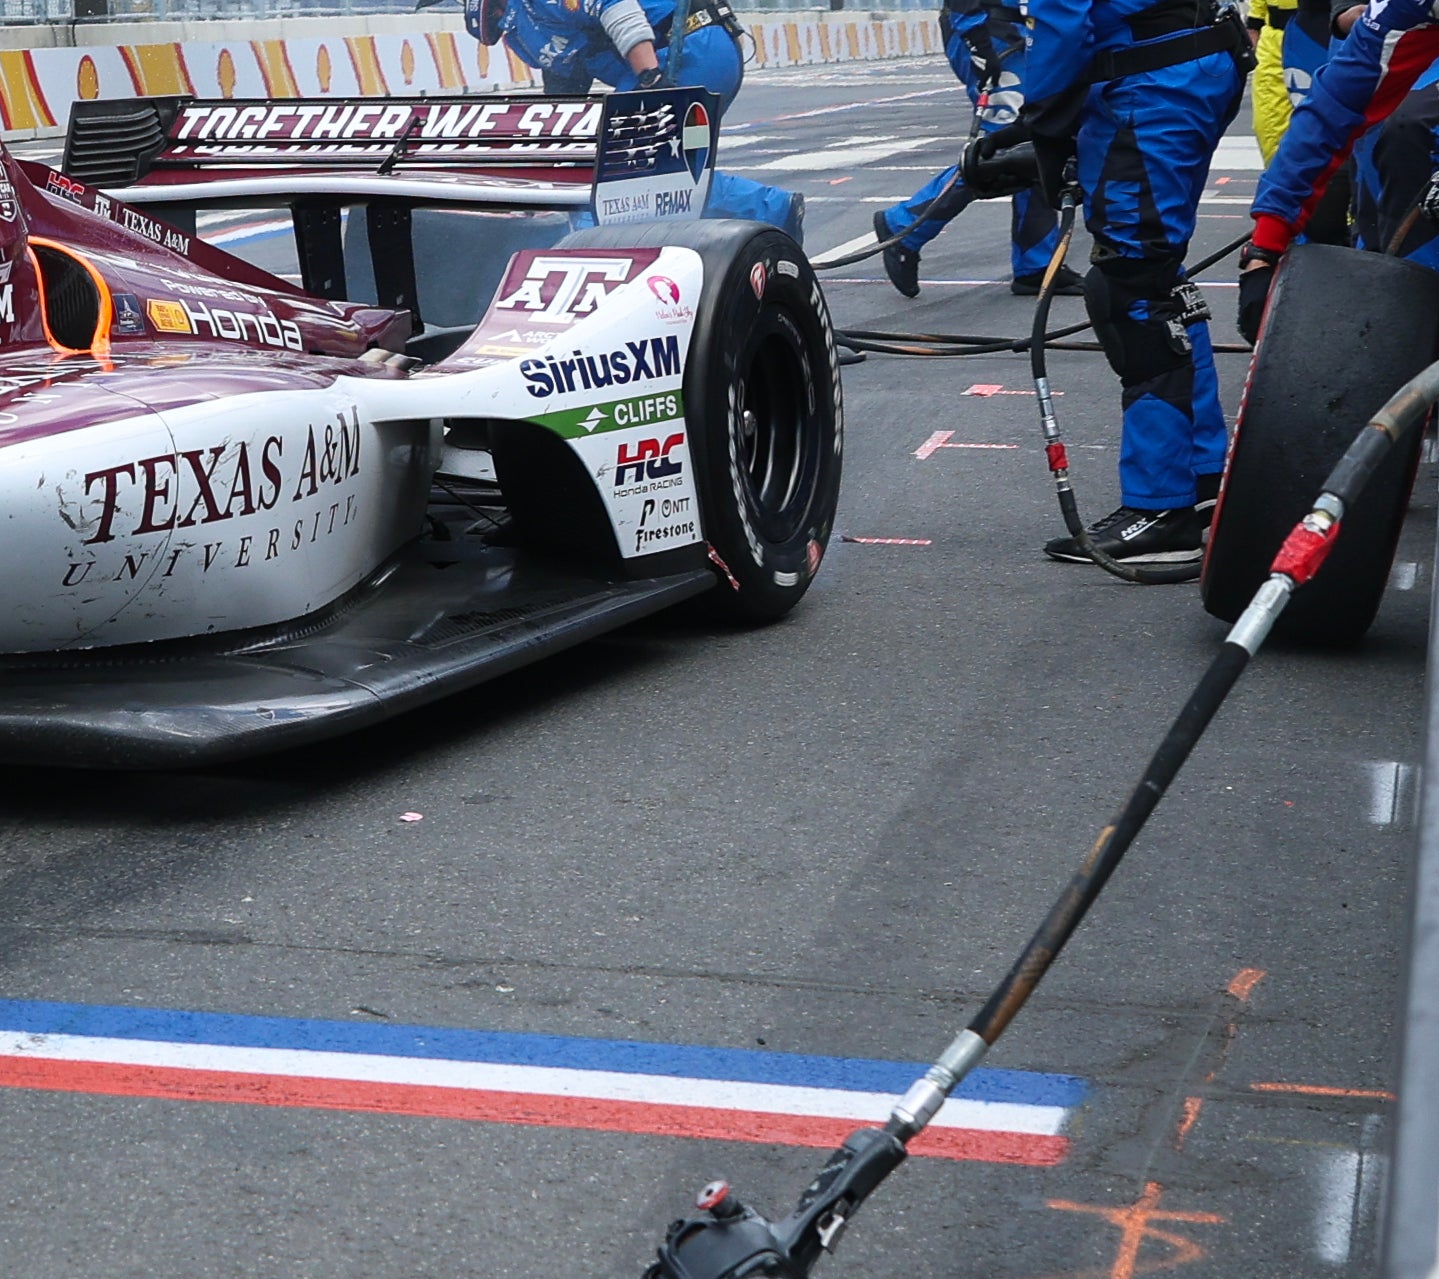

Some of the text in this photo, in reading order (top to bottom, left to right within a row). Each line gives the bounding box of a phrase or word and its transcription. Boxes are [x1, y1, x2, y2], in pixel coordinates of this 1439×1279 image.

[172, 105, 412, 153] TOGETHER
[419, 104, 512, 152] WE
[603, 197, 630, 216] TEXAS
[655, 189, 694, 217] REMAX
[122, 208, 162, 241] TEXAS
[163, 231, 189, 256] A&M
[161, 279, 237, 302] Powered
[179, 299, 303, 352] Honda
[519, 335, 681, 398] SiriusXM
[614, 395, 677, 425] CLIFFS
[83, 405, 361, 545] TEXAS A&M
[614, 433, 685, 487] HRC
[613, 477, 683, 499] Honda RACING
[62, 494, 356, 587] UNIVERSITY
[635, 520, 695, 552] Firestone
